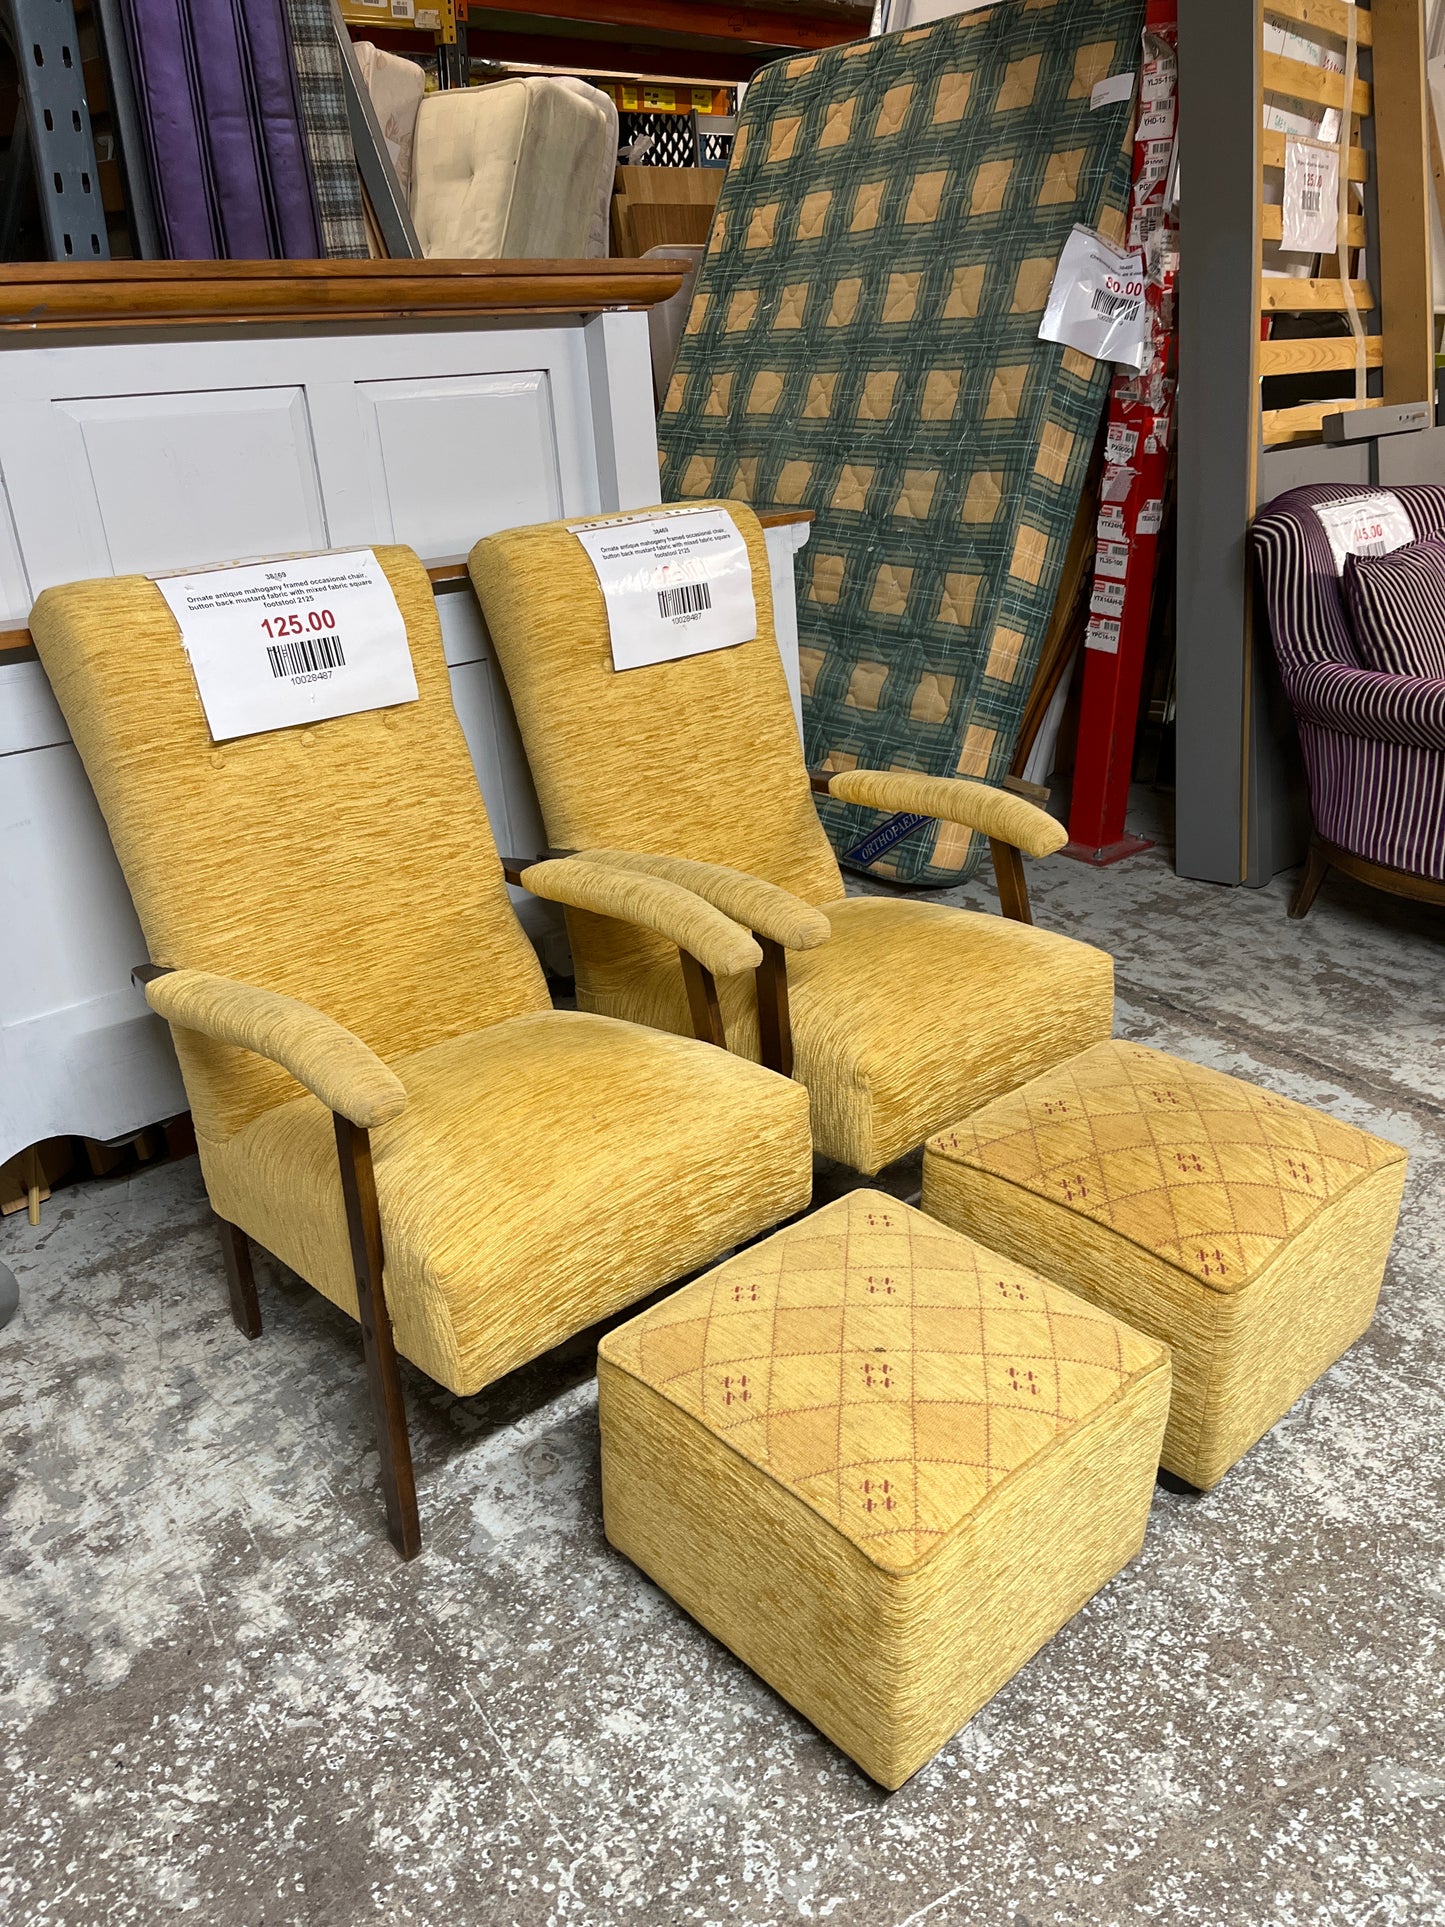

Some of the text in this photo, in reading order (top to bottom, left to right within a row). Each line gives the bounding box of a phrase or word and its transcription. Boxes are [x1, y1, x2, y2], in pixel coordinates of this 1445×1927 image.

[187, 595, 213, 603] Ornate
[215, 590, 243, 600] antique
[244, 584, 282, 595] mahogany
[283, 580, 309, 589] framed
[309, 574, 347, 585] occasional
[188, 579, 372, 611] button back mustard fabric with mixed fabric square
[263, 595, 315, 608] footstool 2125
[261, 609, 336, 638] 125.00
[672, 612, 702, 625] 10028487
[291, 671, 333, 686] 10028487
